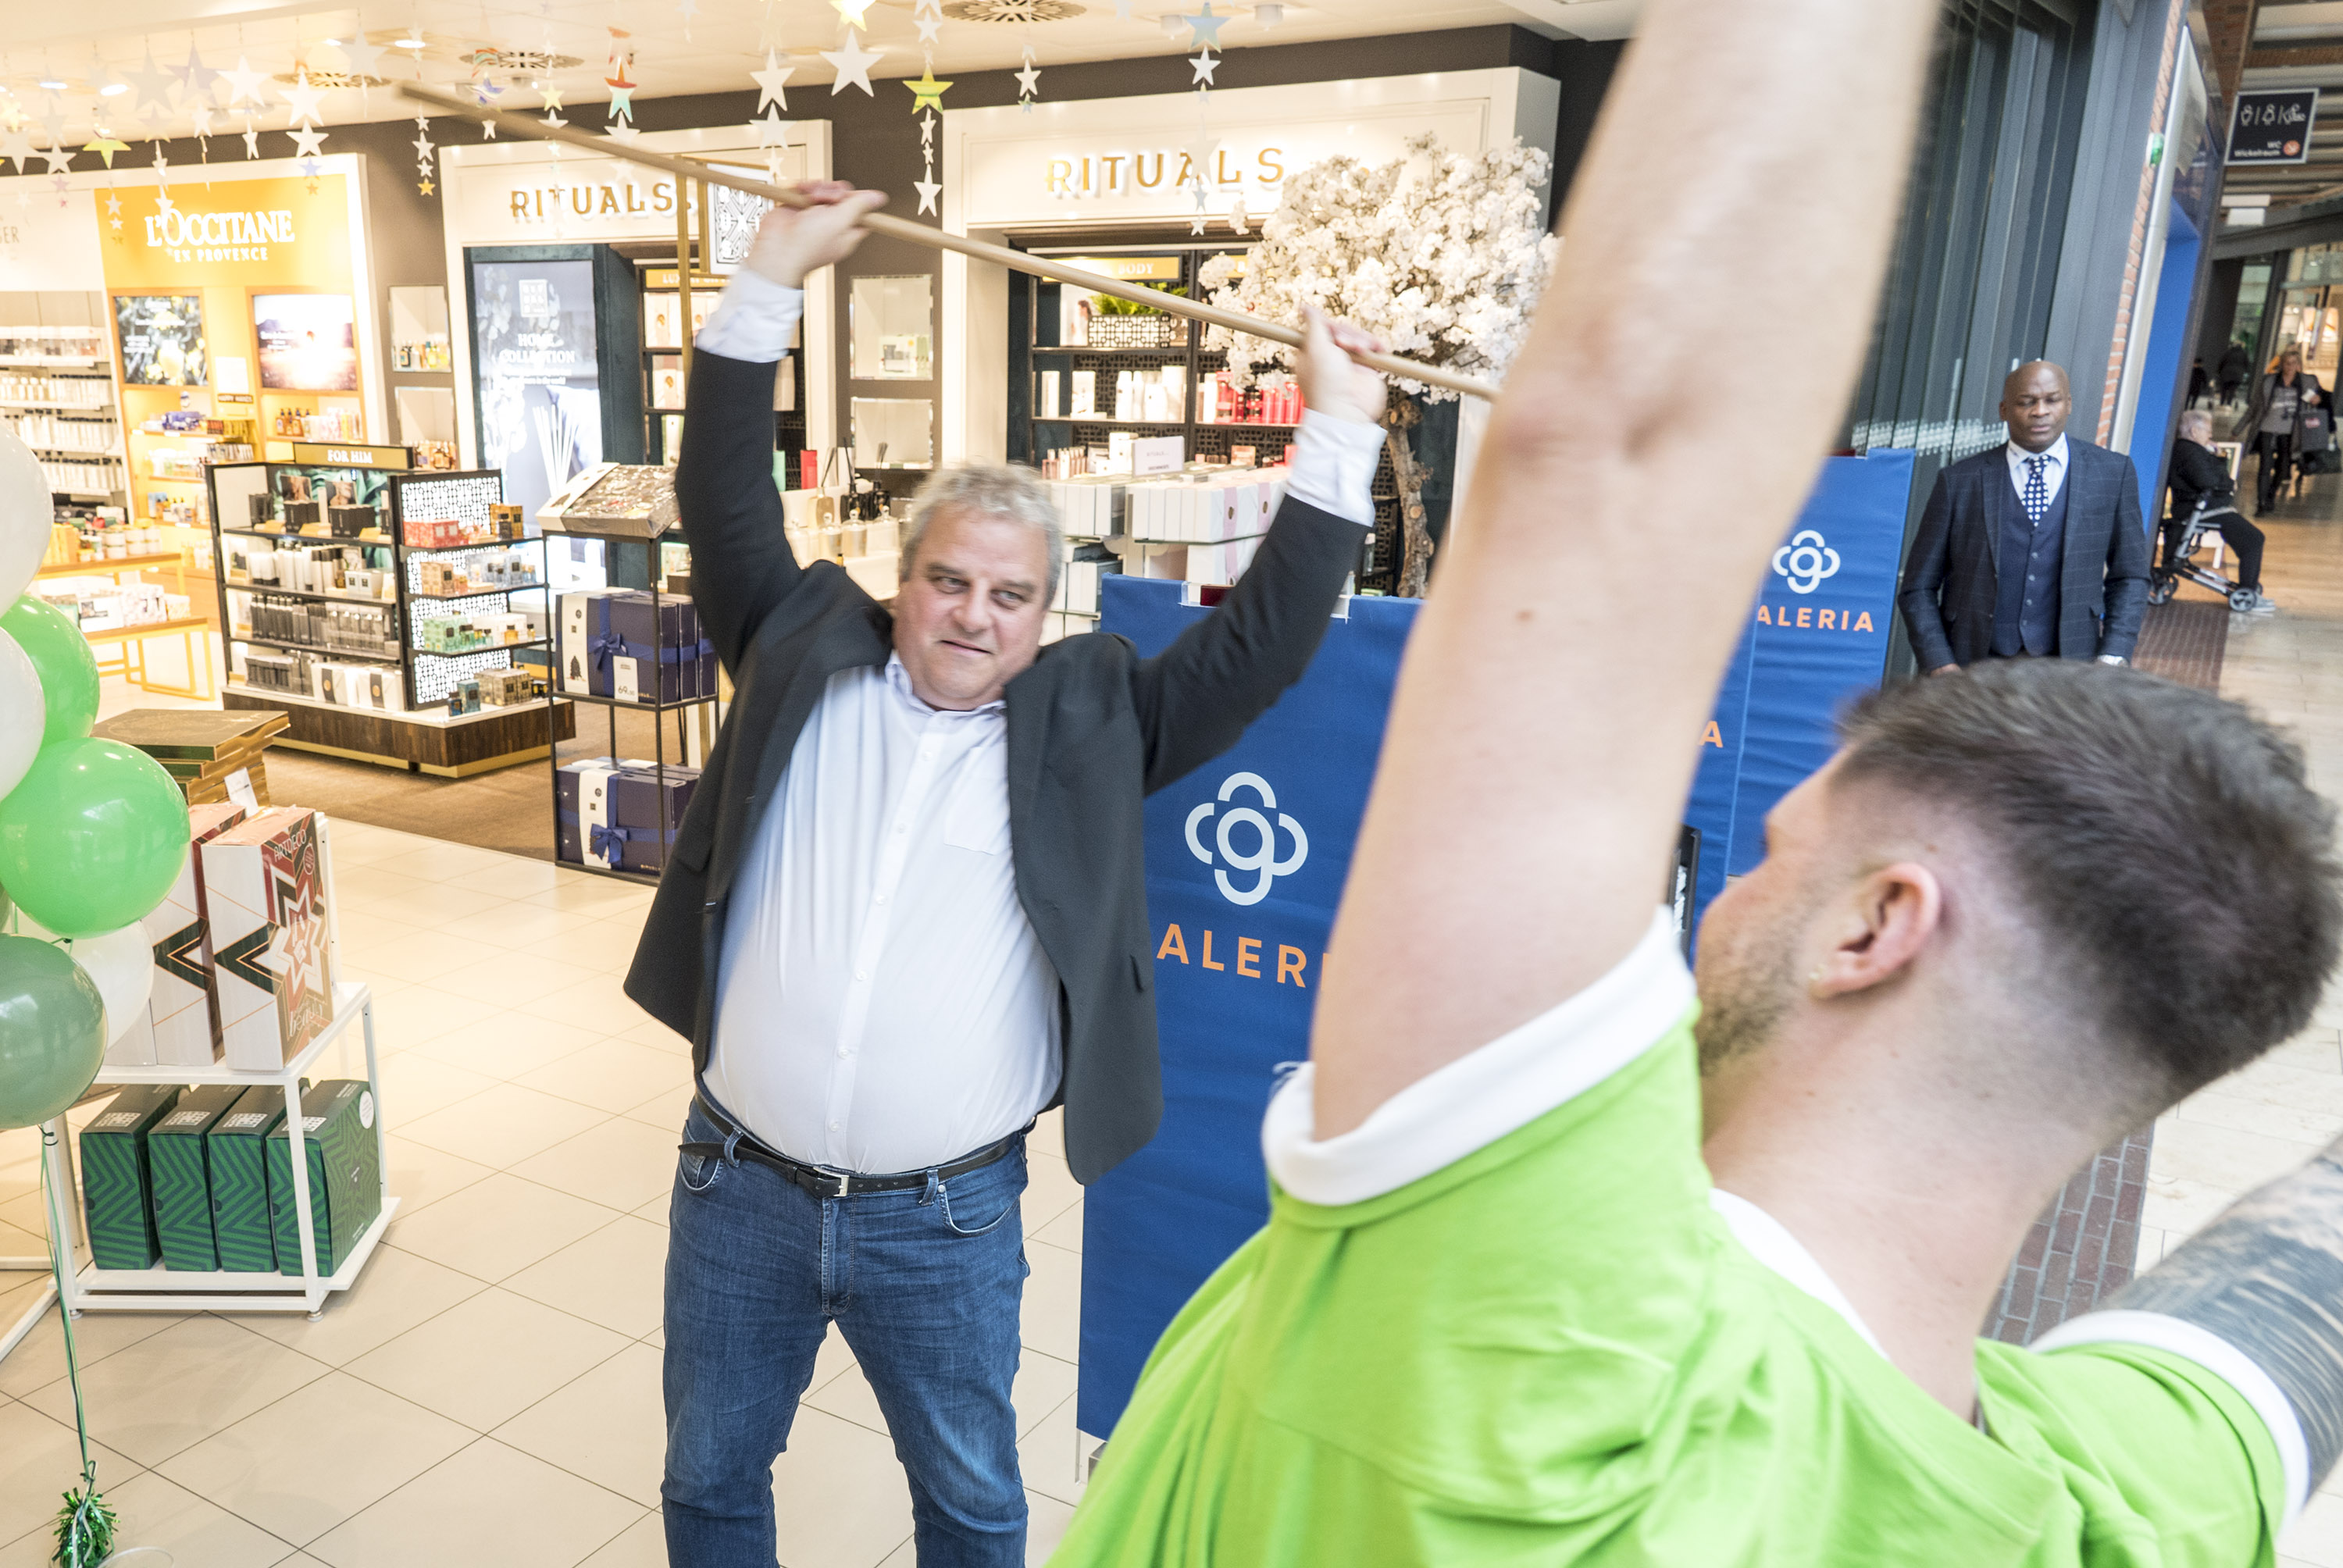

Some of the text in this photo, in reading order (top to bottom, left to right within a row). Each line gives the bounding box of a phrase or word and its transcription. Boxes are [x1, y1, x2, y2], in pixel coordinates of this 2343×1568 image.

[174, 248, 269, 263] EN PROVENCE
[1118, 263, 1154, 275] BODY
[327, 449, 373, 465] FOR HIM
[1757, 605, 1874, 633] ALERIA
[274, 829, 307, 863] ARTDECO
